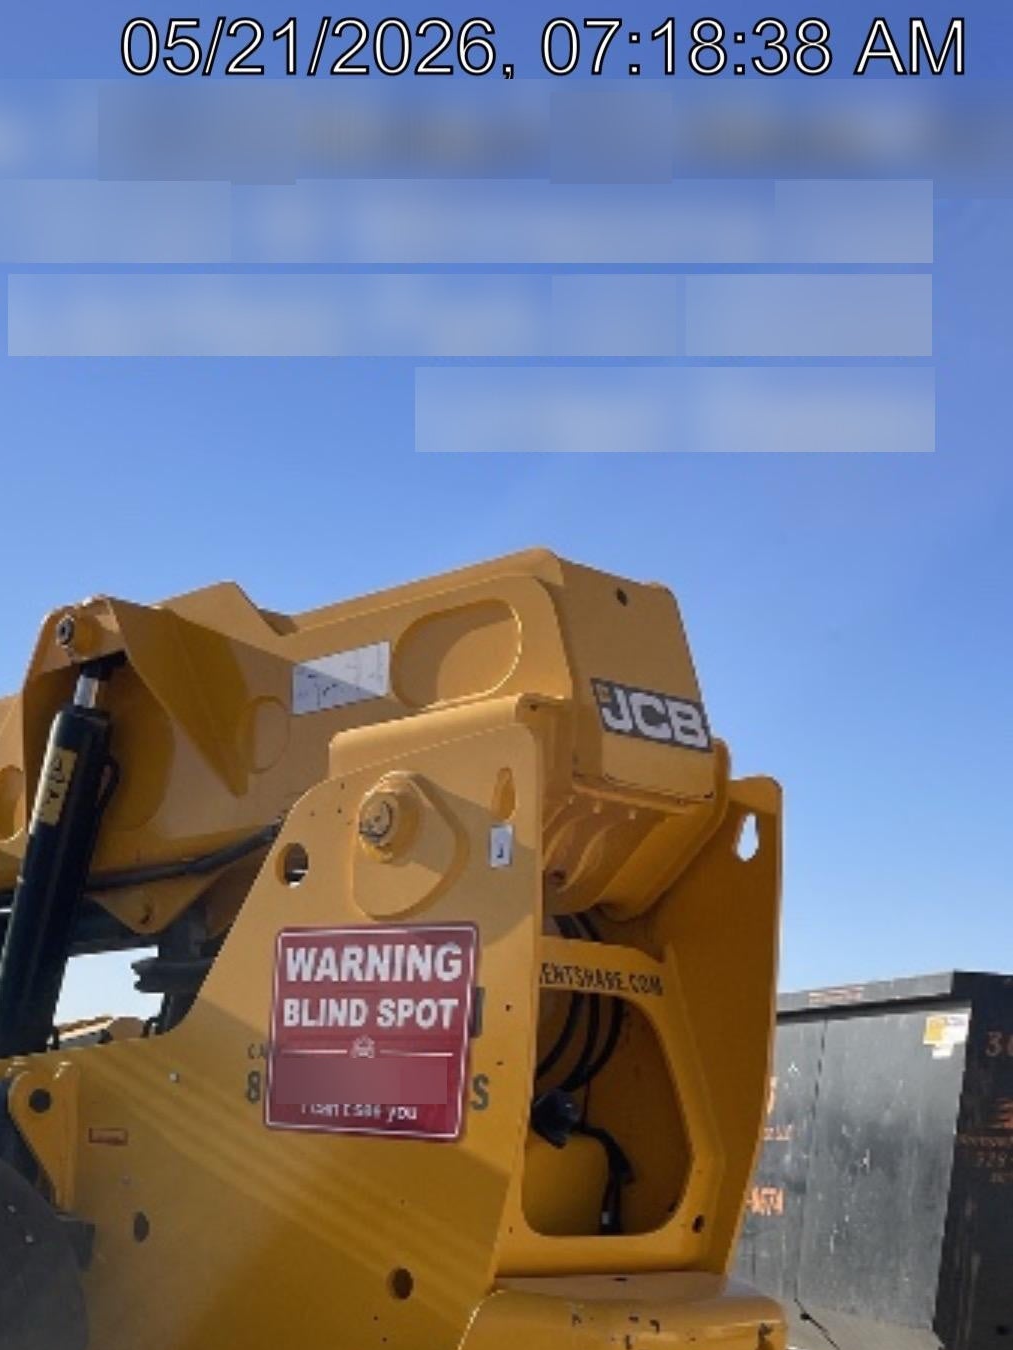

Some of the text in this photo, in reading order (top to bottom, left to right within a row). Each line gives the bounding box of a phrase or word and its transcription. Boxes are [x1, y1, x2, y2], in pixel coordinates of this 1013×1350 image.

[595, 683, 710, 750] JCB
[286, 942, 464, 982] WARNING
[283, 998, 369, 1028] BLIND
[375, 998, 460, 1031] SPOT
